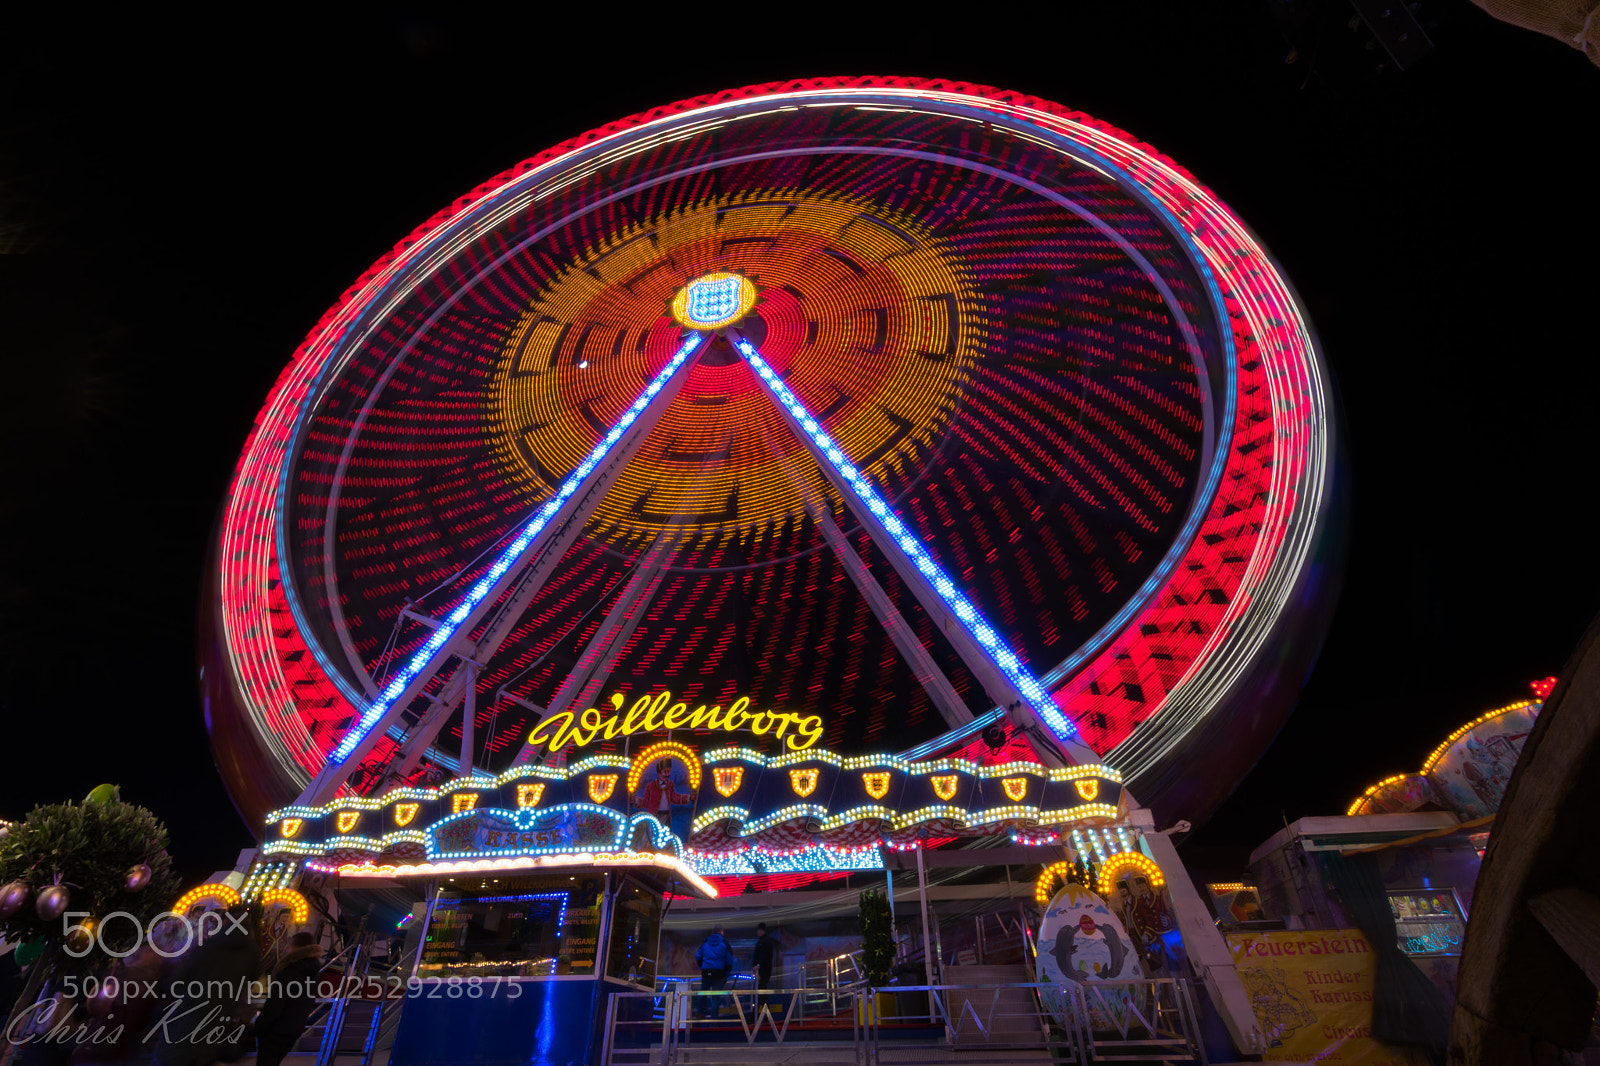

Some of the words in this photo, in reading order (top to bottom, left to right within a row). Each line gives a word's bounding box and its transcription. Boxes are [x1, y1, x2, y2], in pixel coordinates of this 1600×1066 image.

[528, 691, 824, 752] Willenborg
[485, 829, 564, 849] KASSE
[426, 941, 456, 950] EINGANG
[565, 937, 597, 946] EINGANG
[1242, 936, 1369, 957] Feuerstein
[1303, 970, 1370, 985] Kinder-
